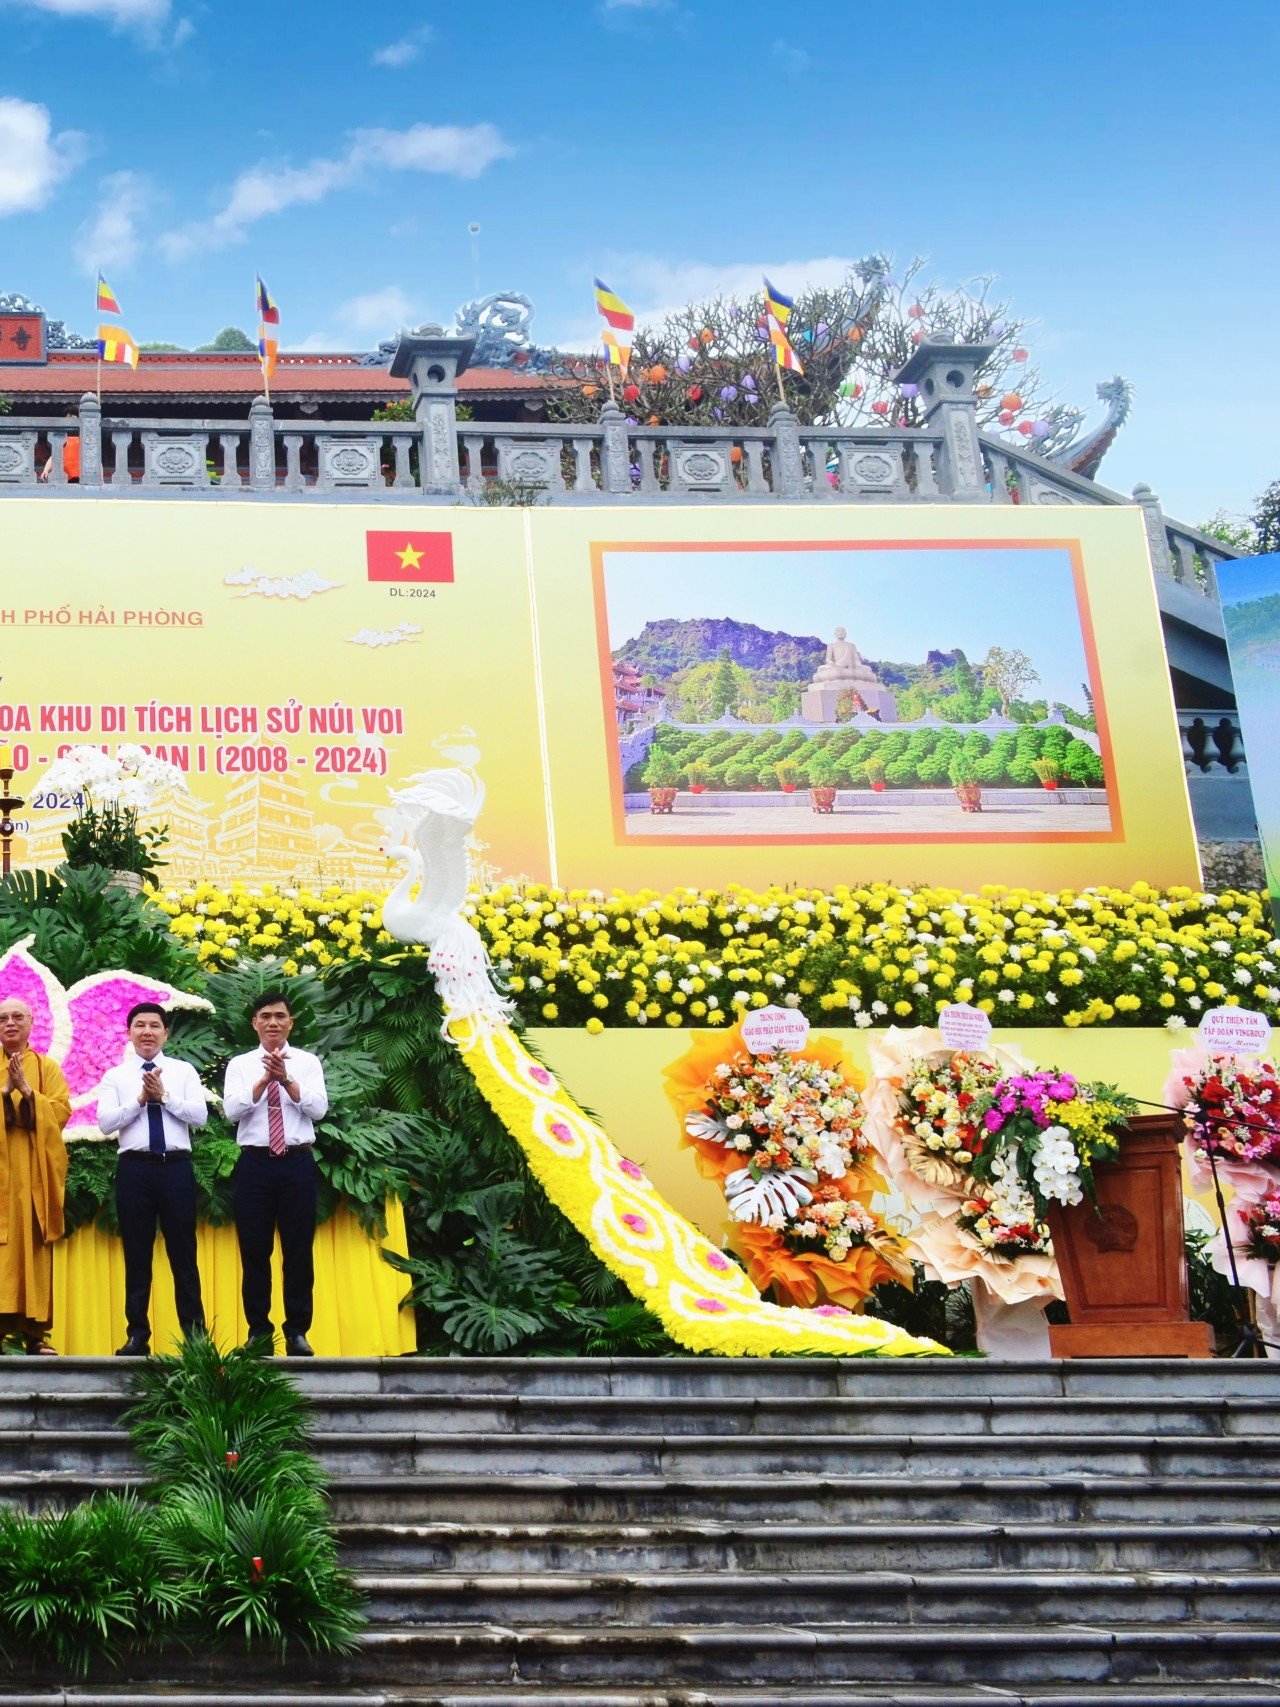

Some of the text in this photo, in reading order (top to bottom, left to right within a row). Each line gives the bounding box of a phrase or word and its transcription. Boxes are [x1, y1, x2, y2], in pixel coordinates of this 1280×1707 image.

[389, 587, 436, 598] DL:2024
[24, 604, 72, 625] PHỐ
[79, 605, 115, 625] HẢI
[124, 607, 204, 626] PHÒNG
[41, 705, 91, 732] KHU
[101, 706, 125, 731] DI
[134, 701, 192, 733] TÍCH
[201, 706, 258, 739] LỊCH
[267, 698, 303, 733] SỬ
[310, 702, 353, 734] NÚI
[362, 708, 403, 734] VOI
[199, 746, 206, 771] I
[216, 746, 288, 775] (2008
[315, 747, 387, 775] 2024)
